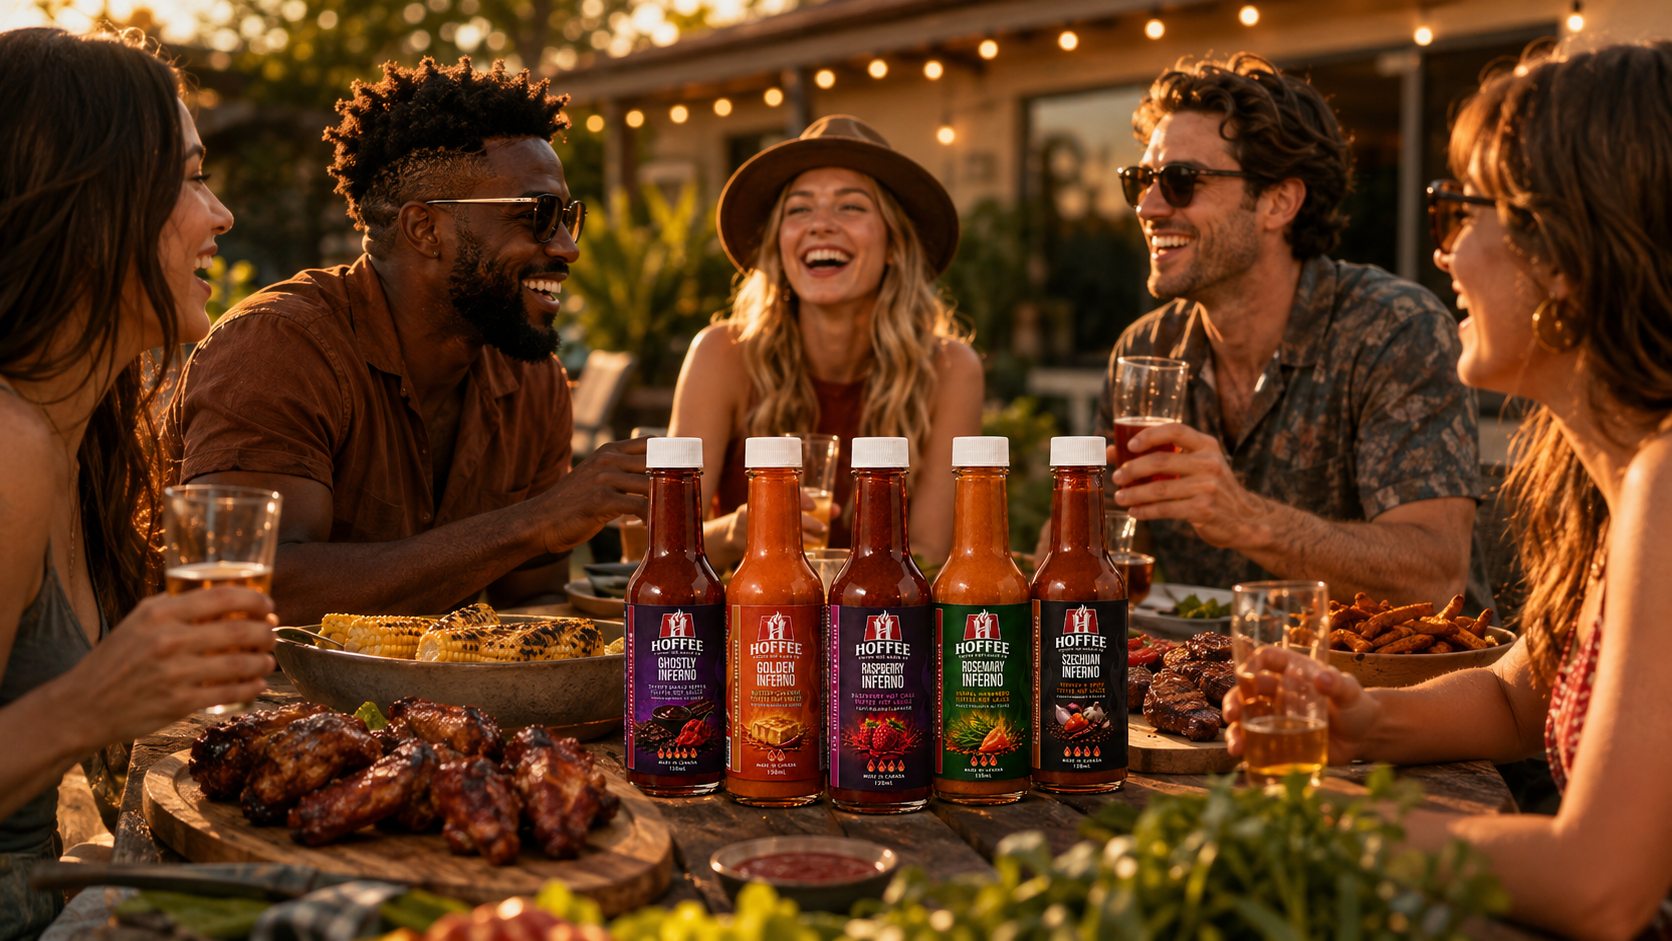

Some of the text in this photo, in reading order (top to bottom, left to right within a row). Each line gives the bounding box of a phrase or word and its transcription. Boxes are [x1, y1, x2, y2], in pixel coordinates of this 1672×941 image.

[651, 638, 704, 652] HOFFEE
[750, 641, 803, 655] HOFFEE
[855, 641, 911, 656] HOFFEE
[955, 640, 1010, 655] HOFFEE
[1055, 634, 1107, 649] HOFFEE
[658, 656, 697, 669] GHOSTLY
[961, 660, 1005, 673] ROSEMARY
[1061, 653, 1101, 666] SZECHUAN
[757, 661, 795, 674] GOLDEN
[861, 662, 905, 675] RASPBERRY
[1062, 665, 1100, 679] INFERNO
[658, 669, 697, 681] INFERNO
[756, 674, 795, 687] INFERNO
[861, 674, 904, 689] INFERNO
[962, 673, 1004, 687] INFERNO
